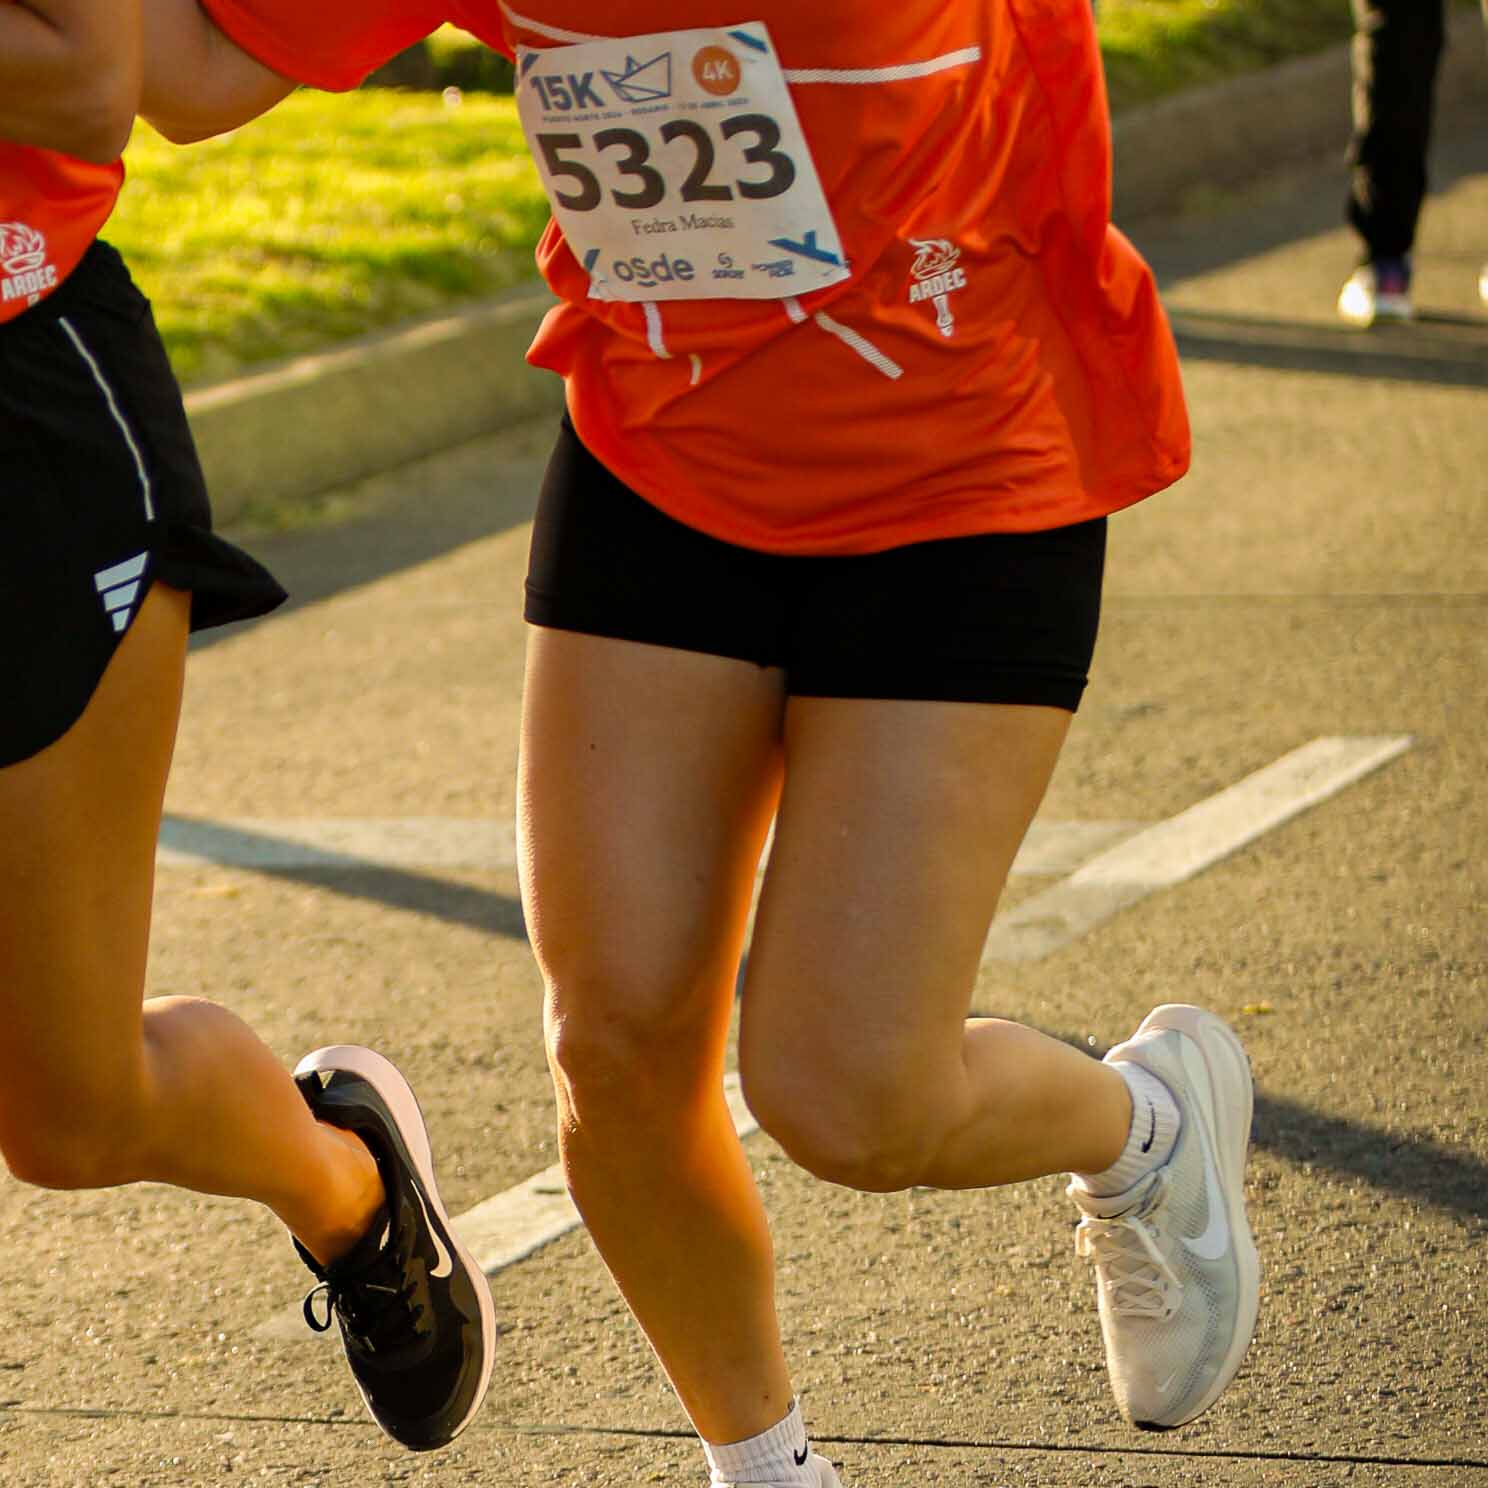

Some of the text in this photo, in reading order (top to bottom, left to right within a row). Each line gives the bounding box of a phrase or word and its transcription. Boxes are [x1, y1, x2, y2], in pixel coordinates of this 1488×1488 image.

[702, 60, 734, 80] 4K
[529, 71, 606, 111] 15K
[535, 113, 796, 212] 5323
[631, 218, 678, 235] Fedra
[613, 253, 695, 283] osde
[909, 268, 967, 304] ARDEC
